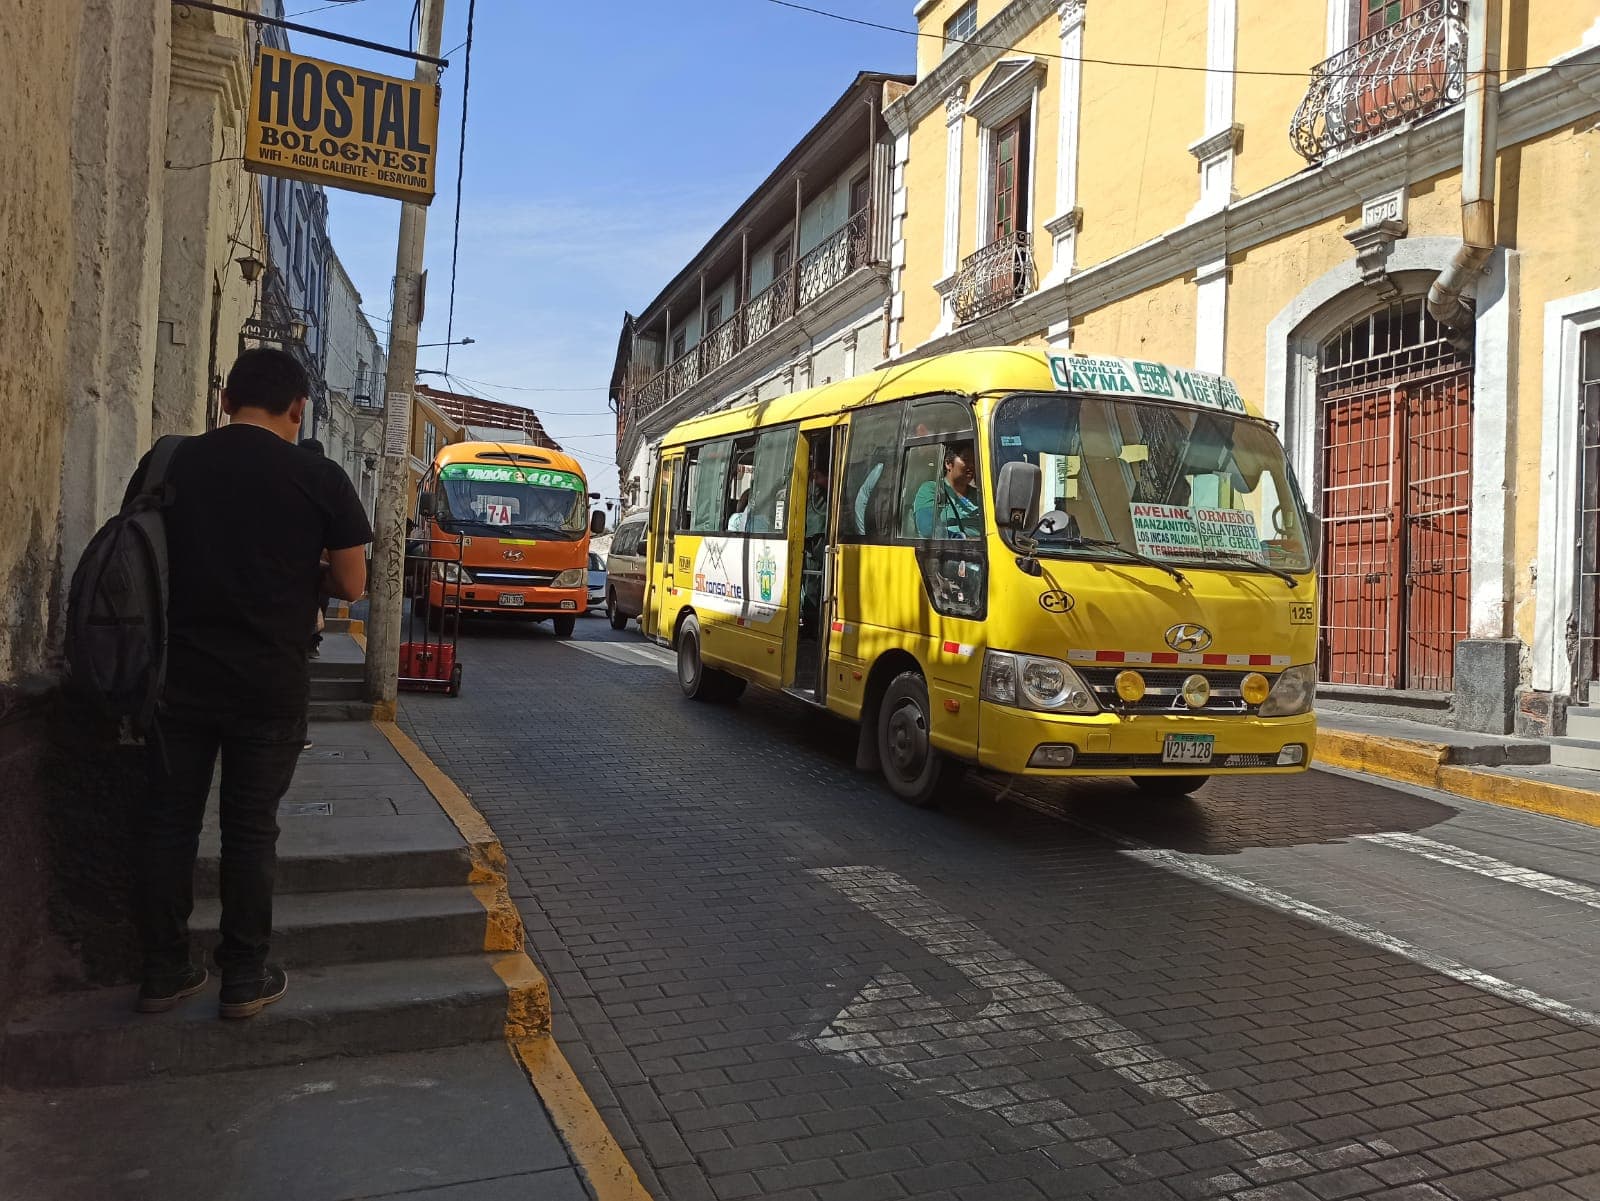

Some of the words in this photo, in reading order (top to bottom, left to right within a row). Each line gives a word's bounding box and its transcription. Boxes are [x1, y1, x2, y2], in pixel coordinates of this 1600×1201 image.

[258, 54, 431, 155] HOSTAL
[260, 126, 428, 175] BOLOGNESI
[259, 147, 282, 161] WIFI
[291, 154, 319, 169] AGUA
[322, 158, 368, 177] CALIENTE
[377, 170, 428, 188] DESAYUNO
[1068, 357, 1097, 366] RADIO
[1099, 360, 1124, 368] AZUL
[1071, 364, 1126, 375] TOMILLA
[1140, 364, 1160, 374] RUTA
[1174, 370, 1197, 401] 11
[1196, 387, 1212, 404] DE
[487, 505, 510, 524] 7-A
[1198, 510, 1254, 525] ORMEÑO
[1134, 518, 1198, 533] MANZANITOS
[1199, 522, 1258, 538] SALAVERRY
[1136, 530, 1150, 542] LOS
[1150, 532, 1170, 544] INCAS
[1230, 538, 1260, 550] GRAU
[1042, 592, 1070, 610] C-1
[1291, 607, 1313, 620] 125
[1166, 741, 1212, 758] V2Y-128
